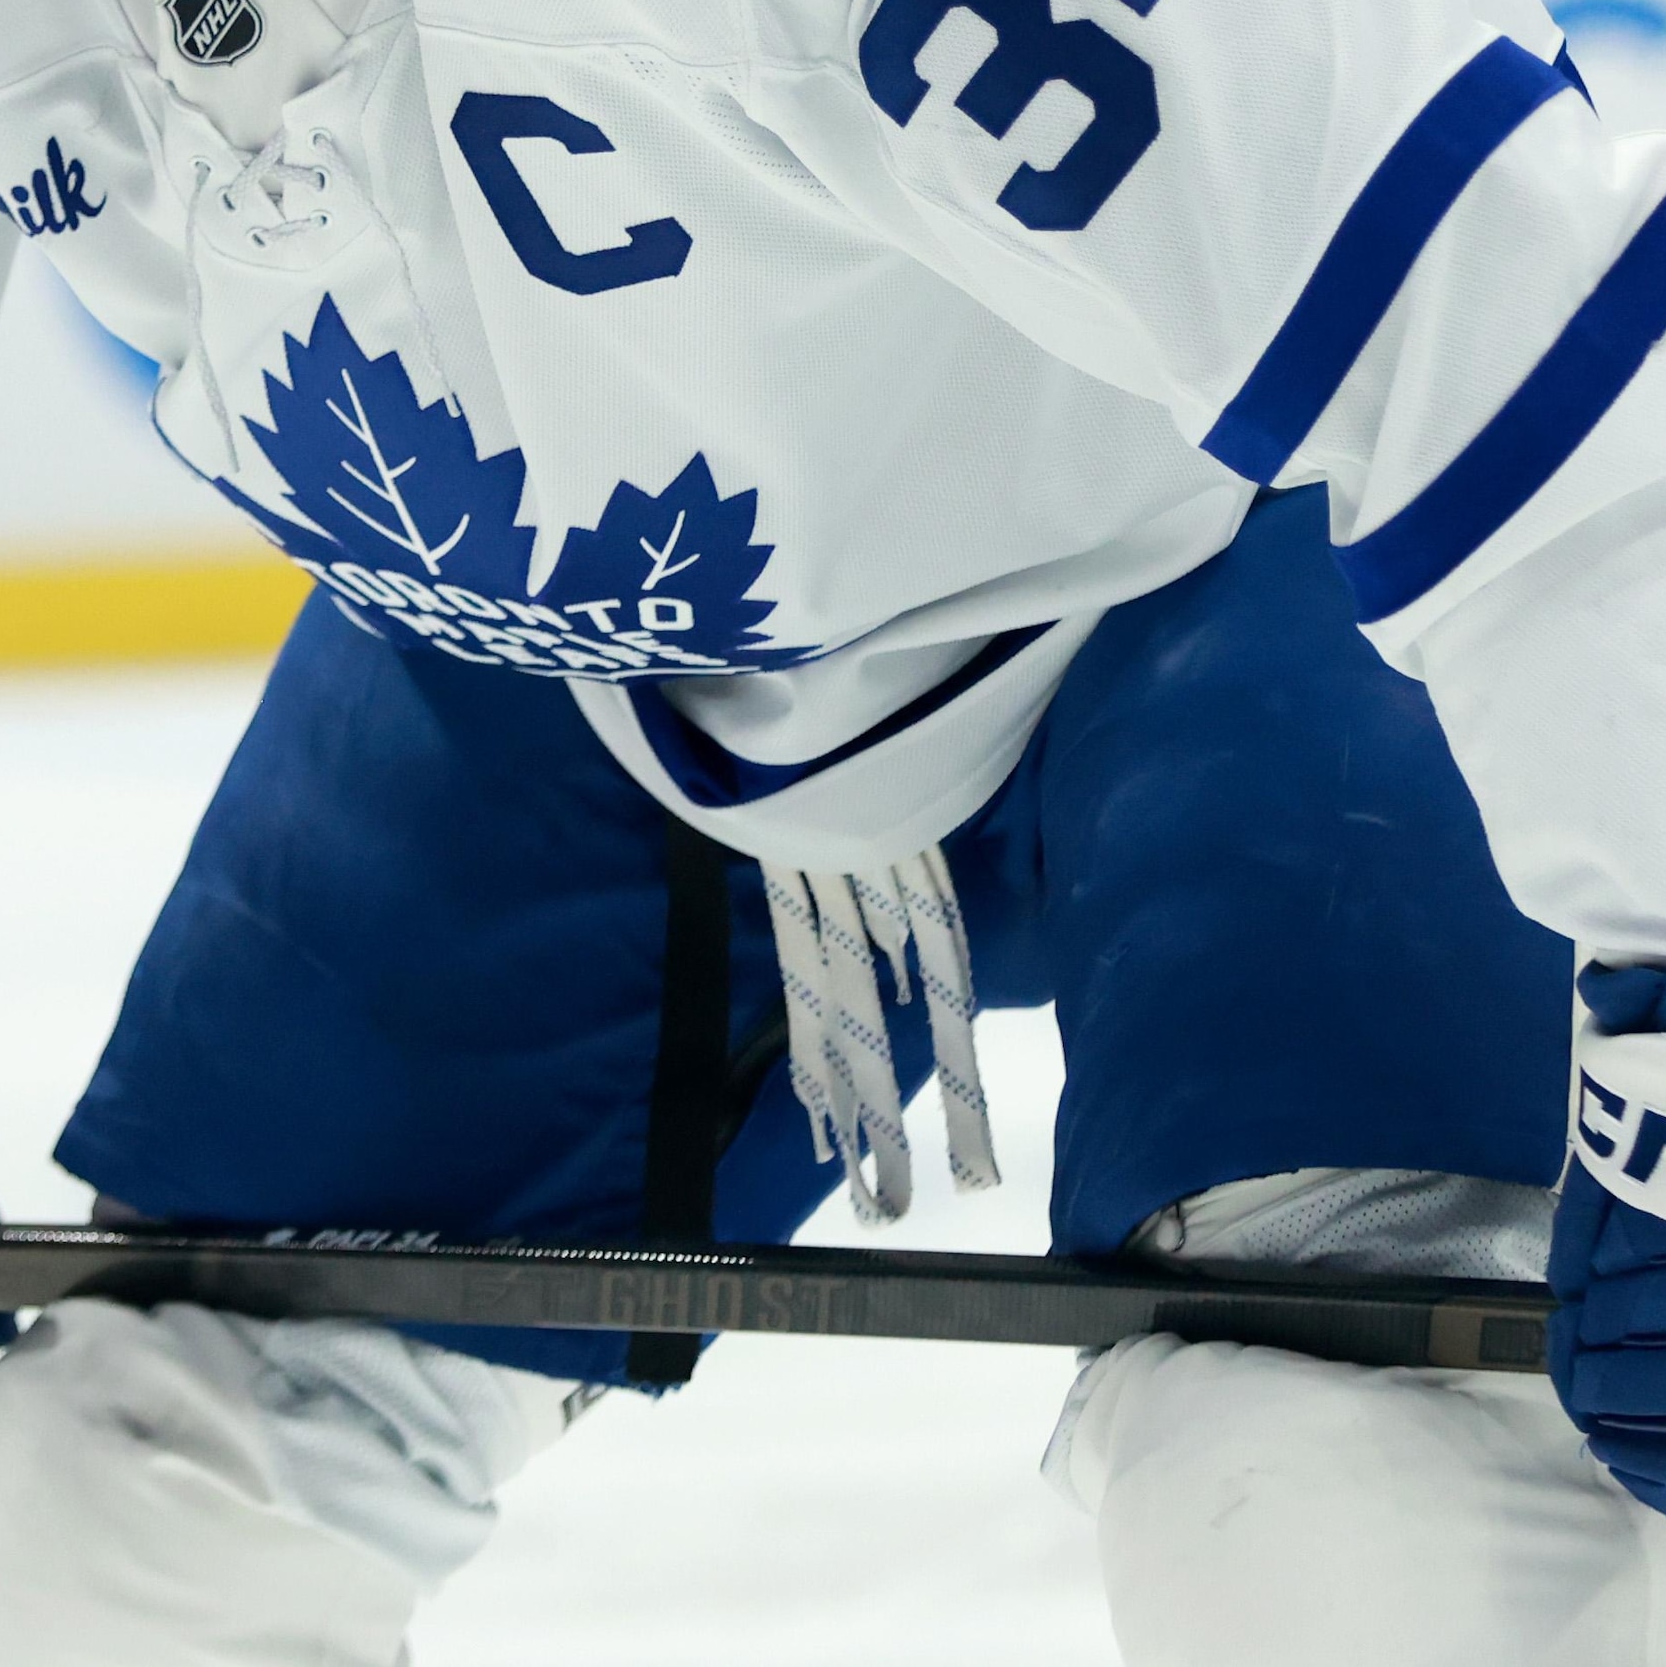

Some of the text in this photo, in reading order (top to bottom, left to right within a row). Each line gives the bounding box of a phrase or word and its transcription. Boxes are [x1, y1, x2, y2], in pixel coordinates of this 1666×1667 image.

[449, 91, 693, 296] C
[291, 556, 694, 632] TORONTO
[600, 1270, 847, 1332] GHOST
